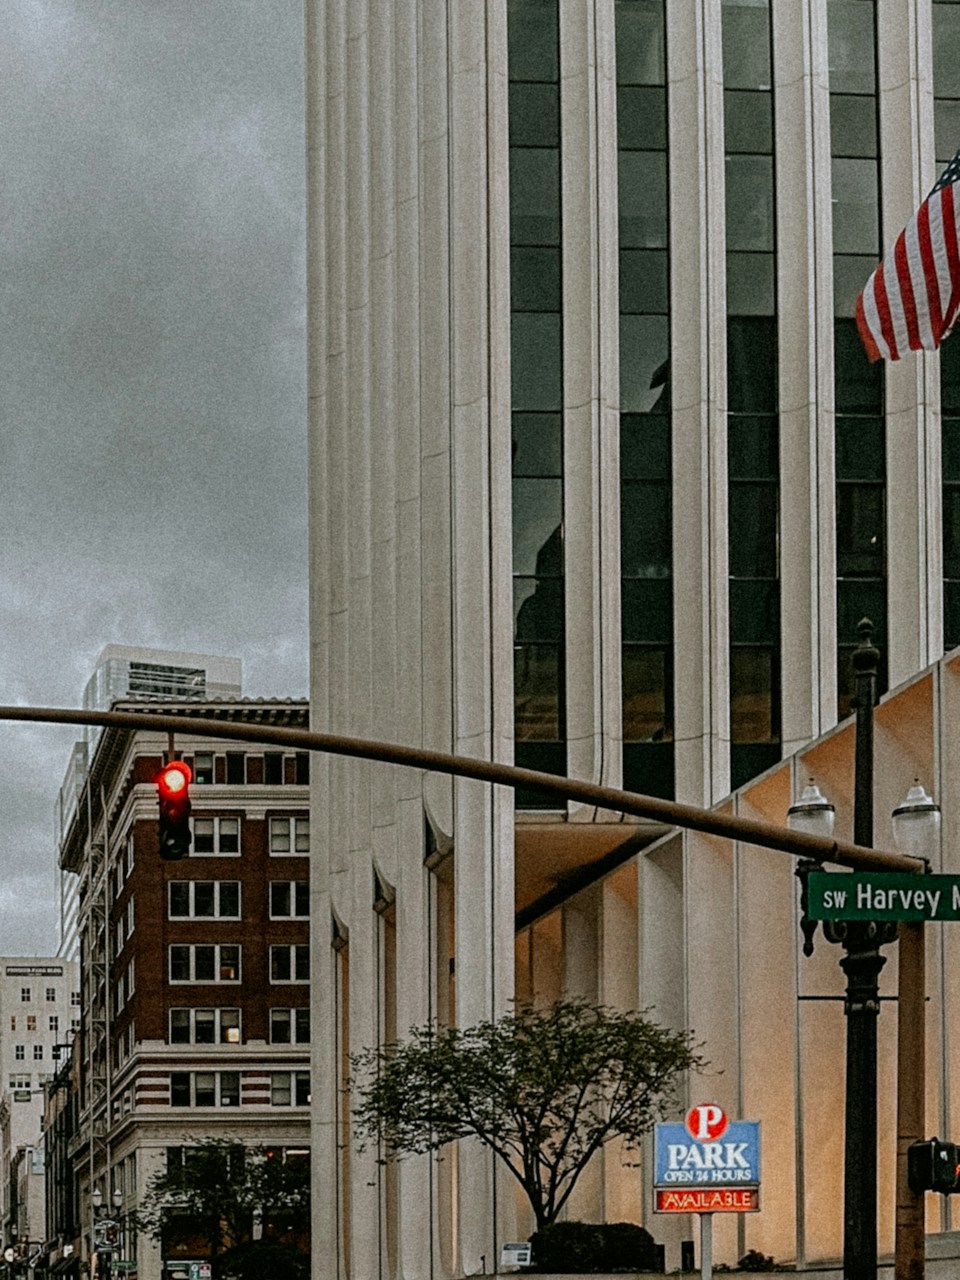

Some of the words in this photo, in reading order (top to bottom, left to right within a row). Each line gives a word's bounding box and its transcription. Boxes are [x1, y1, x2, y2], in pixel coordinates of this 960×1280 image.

[823, 891, 847, 909] SW
[857, 883, 942, 917] Harvey
[696, 1106, 724, 1139] P
[667, 1143, 751, 1169] PARK
[663, 1169, 694, 1182] OPEN
[695, 1170, 709, 1181] 24
[711, 1168, 752, 1181] HOURS
[664, 1191, 752, 1208] AVAILABLE
